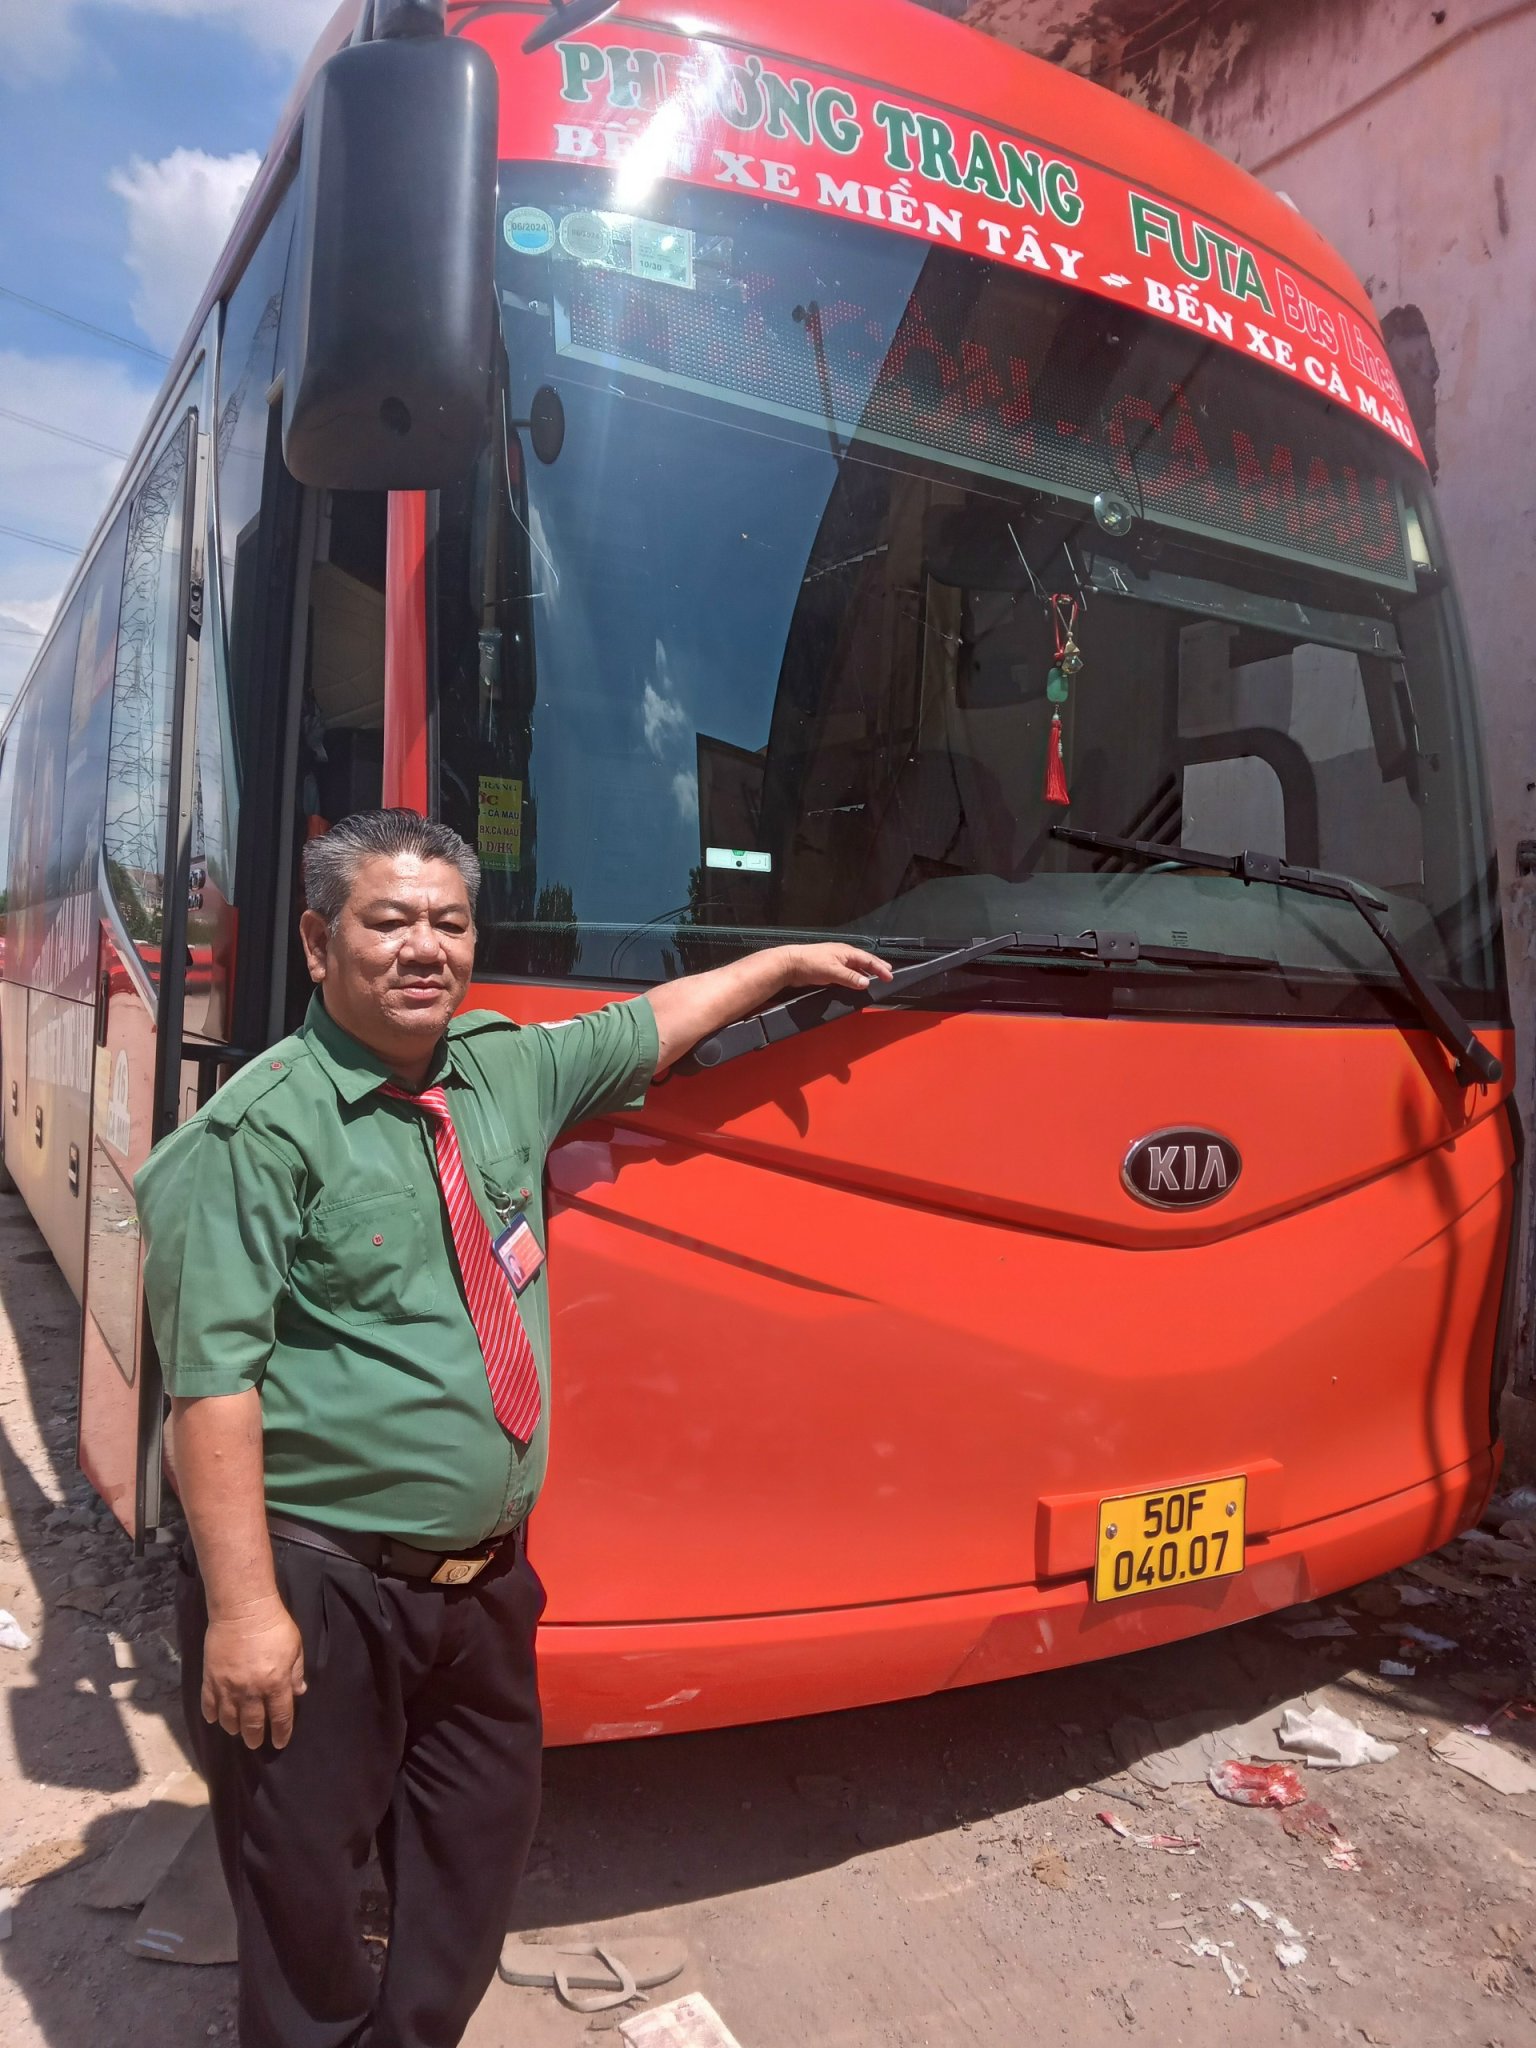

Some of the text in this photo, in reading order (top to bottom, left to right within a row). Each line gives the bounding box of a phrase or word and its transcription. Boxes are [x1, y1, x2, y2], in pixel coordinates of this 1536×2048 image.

[555, 41, 863, 155] PHƠNG
[873, 100, 1084, 226] TRANG
[1128, 190, 1276, 318] FUTA
[511, 222, 548, 233] 06/2024
[554, 117, 1413, 448] BẾ XE MIỀN TÂY BẾN XE CÀ MAU
[1148, 1145, 1227, 1191] KIA
[1144, 1489, 1207, 1540] 50F
[1114, 1530, 1229, 1592] 040.07
